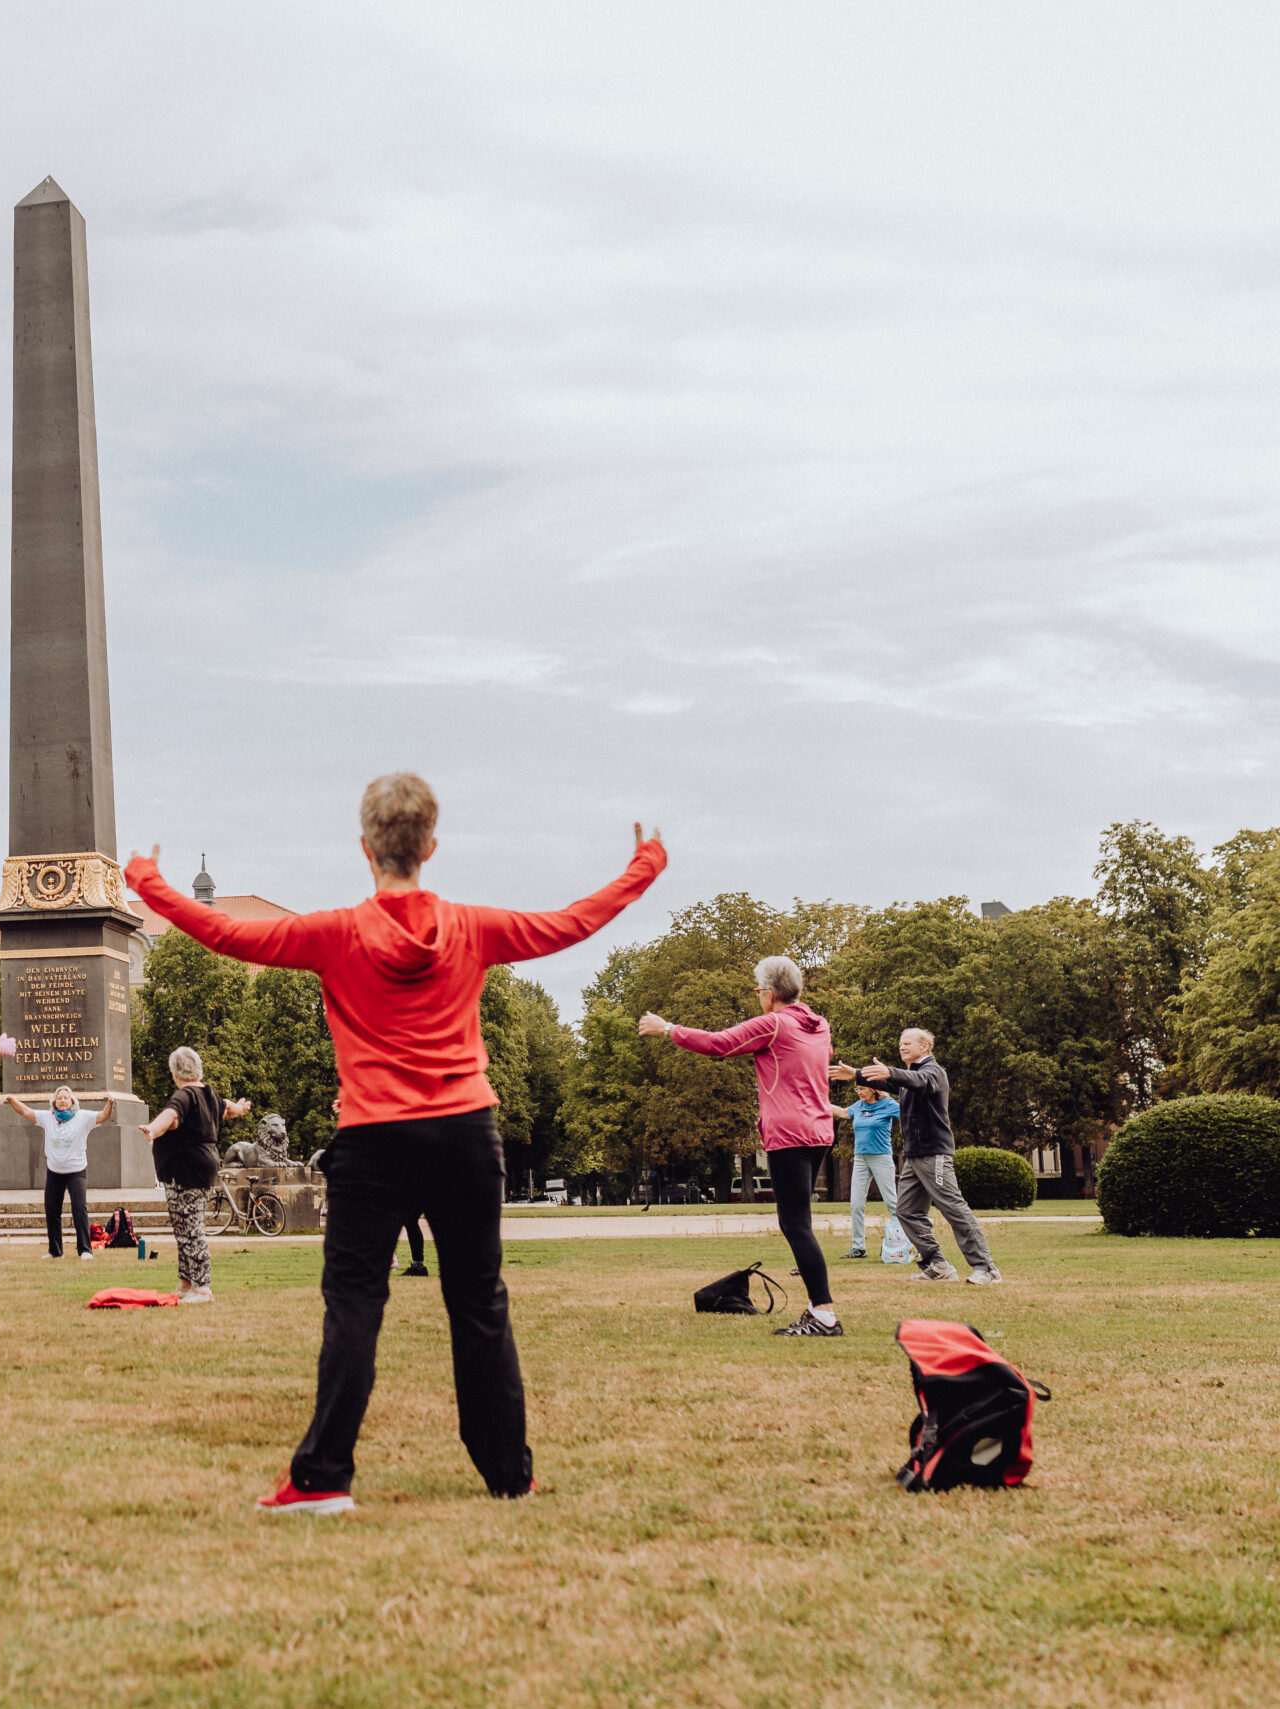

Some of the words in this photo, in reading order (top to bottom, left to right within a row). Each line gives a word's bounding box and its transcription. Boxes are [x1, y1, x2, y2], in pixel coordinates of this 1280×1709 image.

[45, 973, 87, 981] VATERLAND
[35, 997, 70, 1005] WEHREND
[31, 1023, 77, 1034] WELFE
[16, 1038, 40, 1049] ARL
[42, 1036, 99, 1048] WILHELM
[15, 1051, 93, 1063] FERDINAND
